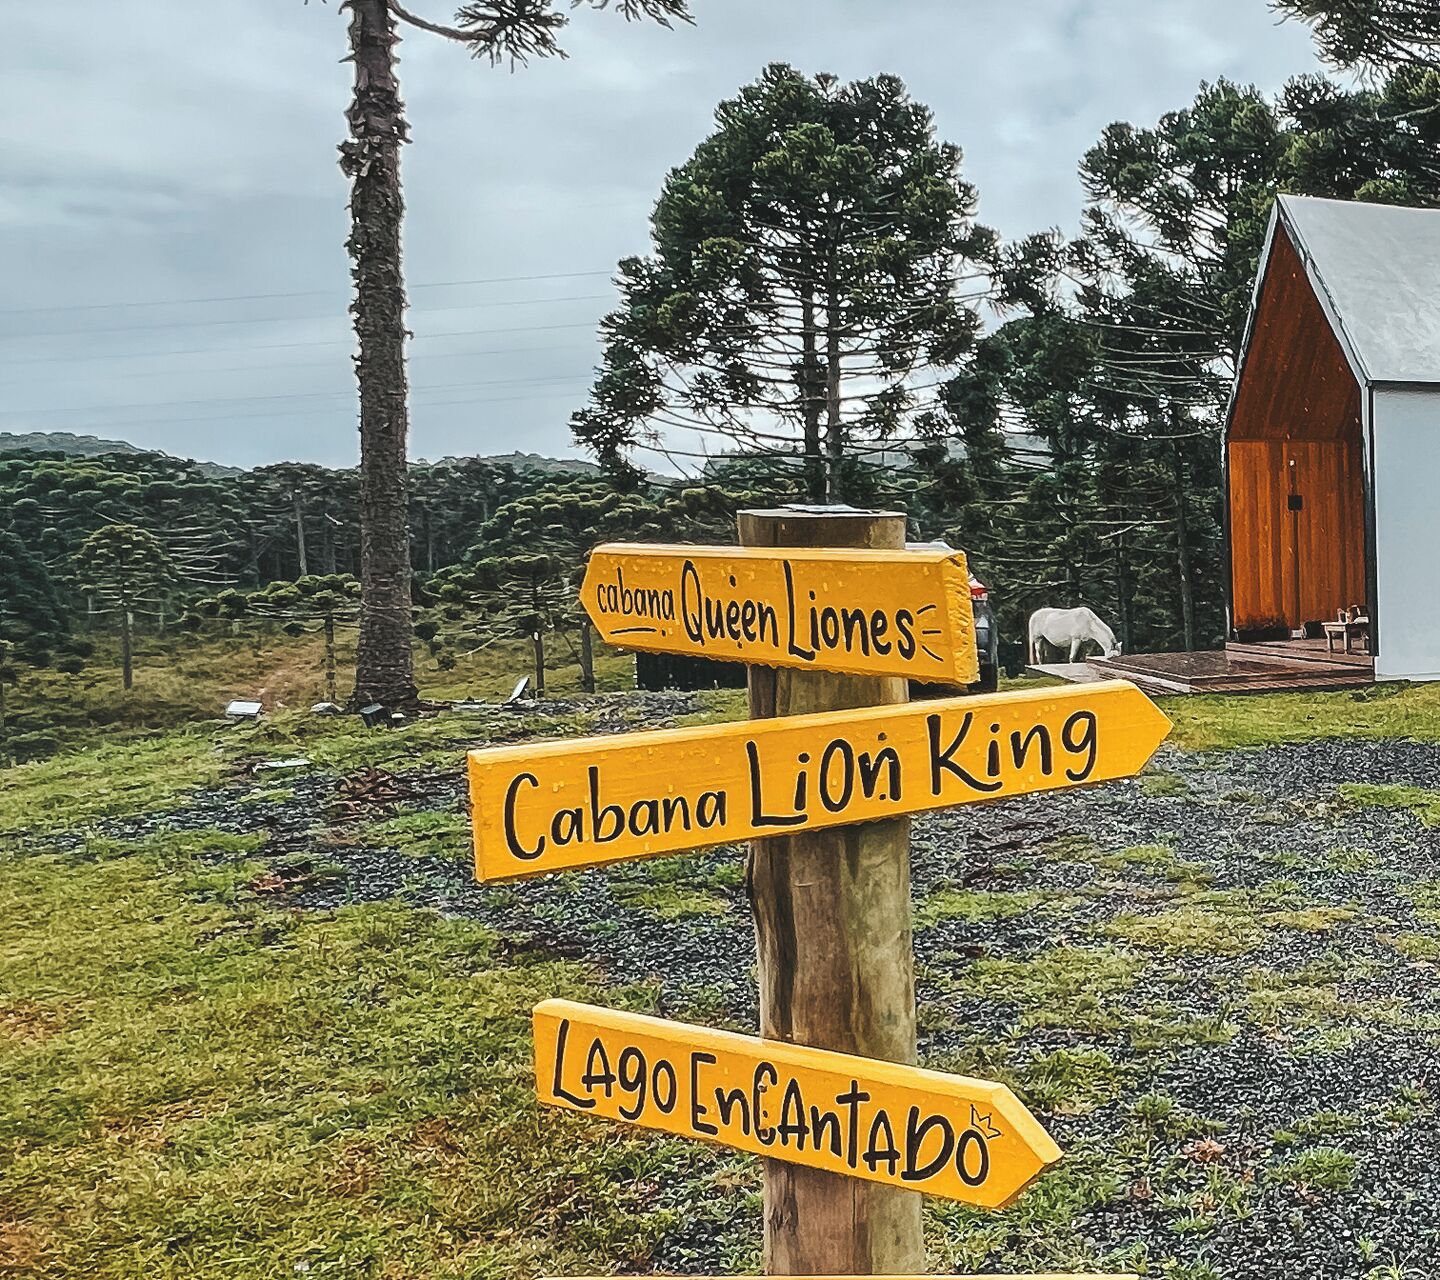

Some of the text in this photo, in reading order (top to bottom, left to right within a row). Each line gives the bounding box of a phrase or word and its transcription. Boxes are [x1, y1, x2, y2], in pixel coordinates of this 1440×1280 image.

[680, 558, 779, 643] Queen
[783, 559, 916, 661] Liones
[504, 765, 727, 860] Cabana
[926, 709, 1099, 796] King
